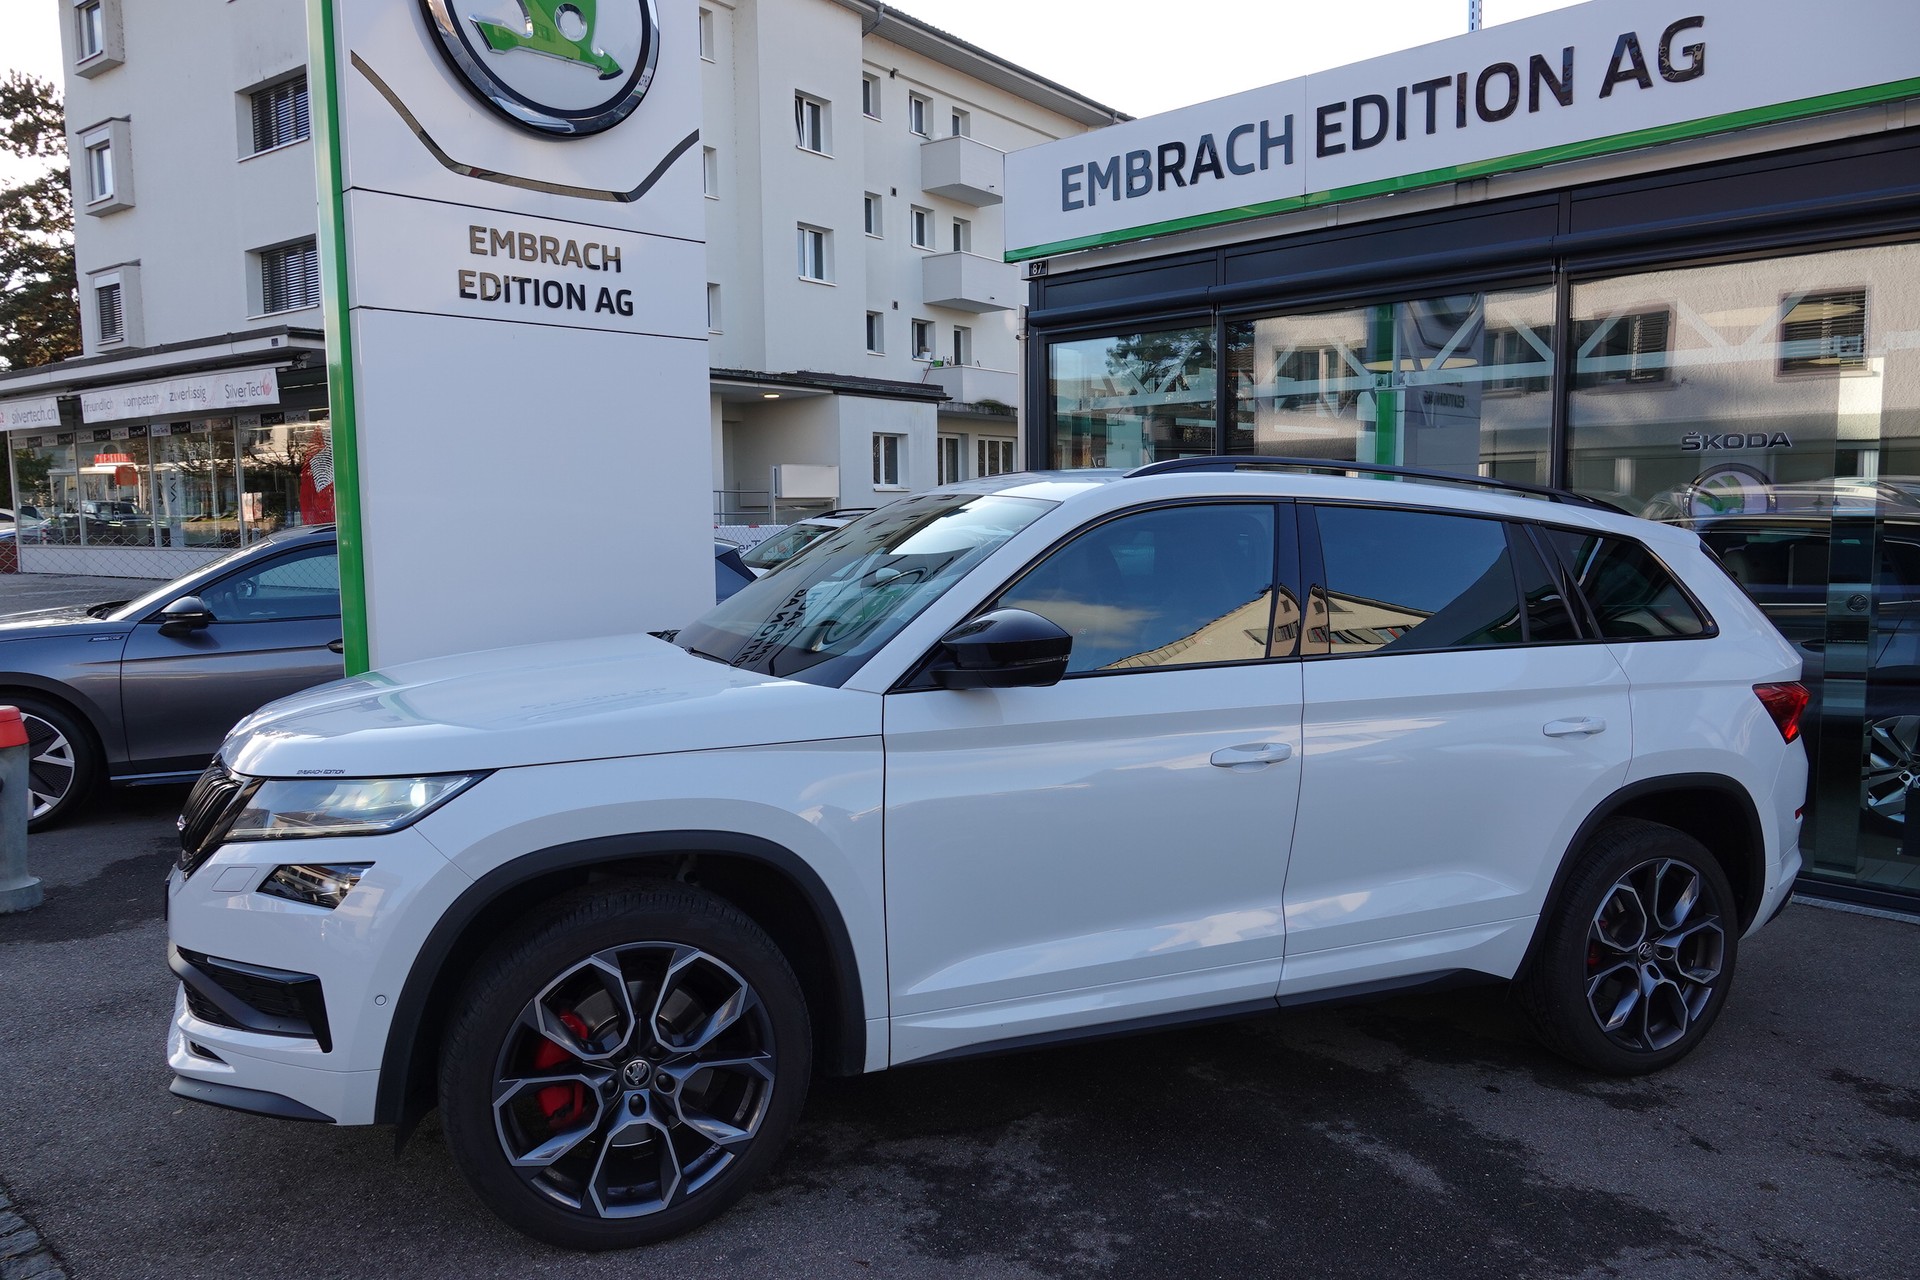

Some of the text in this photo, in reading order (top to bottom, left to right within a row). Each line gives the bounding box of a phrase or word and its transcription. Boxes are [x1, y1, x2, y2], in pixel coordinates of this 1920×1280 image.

[1061, 15, 1706, 212] EMBRACH EDITION AG
[469, 225, 622, 273] EMBRACH
[1032, 262, 1043, 275] 87
[458, 269, 634, 317] EDITION AG
[123, 393, 160, 410] ompetent
[224, 380, 266, 399] SilverTech
[12, 403, 57, 425] silvertech.ch
[1681, 431, 1792, 450] ŠKODA
